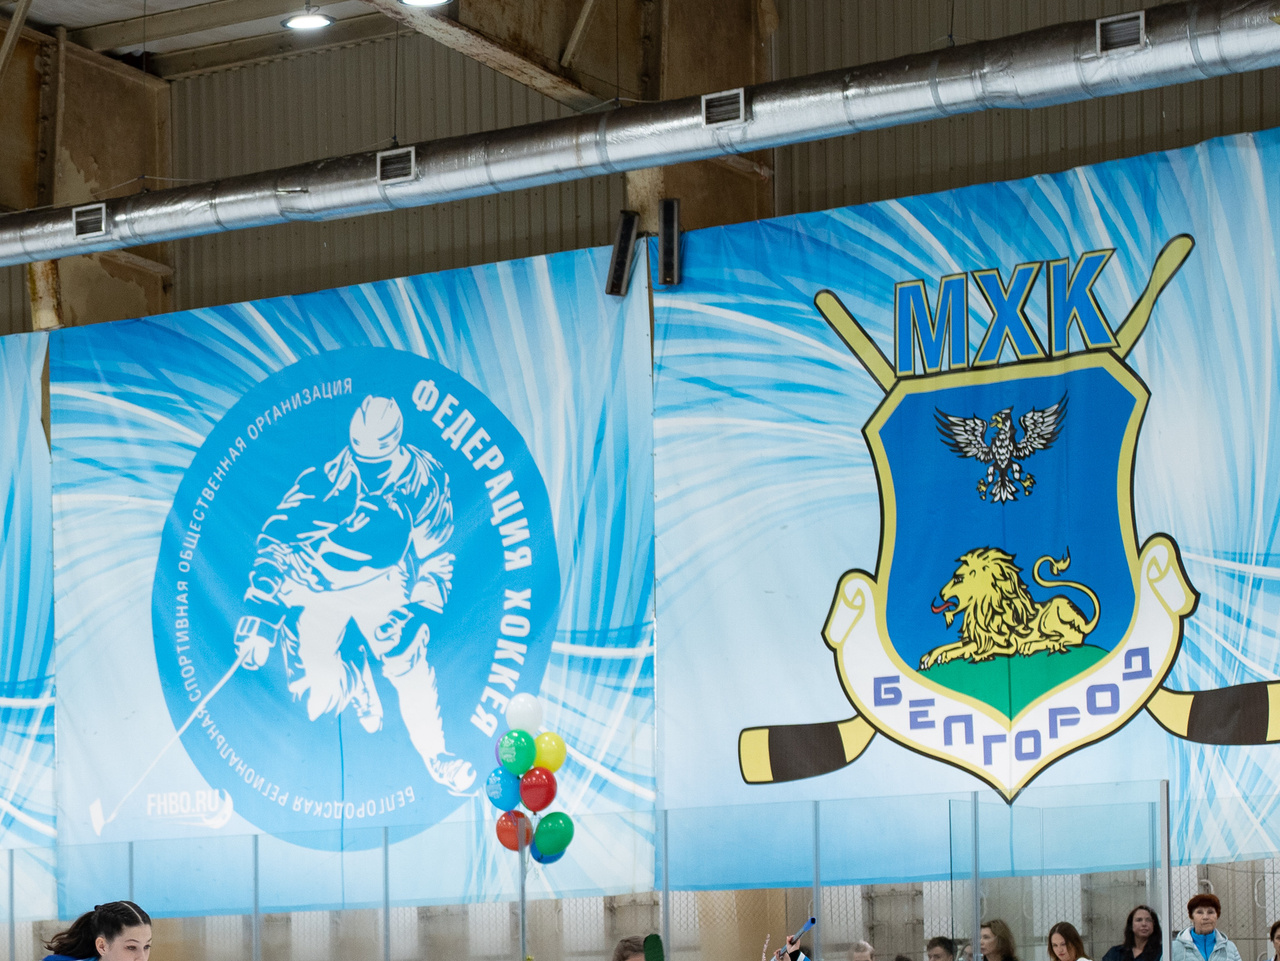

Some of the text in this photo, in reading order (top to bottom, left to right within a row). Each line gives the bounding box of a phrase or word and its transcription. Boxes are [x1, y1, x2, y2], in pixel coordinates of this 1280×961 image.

[892, 247, 1122, 380] МХК
[175, 376, 415, 820] БЕЛГОРОДСКАЯ РЕГИОНАЛЬНАЯ СПОРТИВНАЯ ОБЩЕСТВЕННАЯ ОРГАНИЗАЦИЯ
[411, 379, 532, 739] ФЕДЕРАЦИЯ ХОККЕЯ
[873, 646, 1153, 766] БЕЛГОРОД
[146, 788, 220, 816] FHBO.RU
